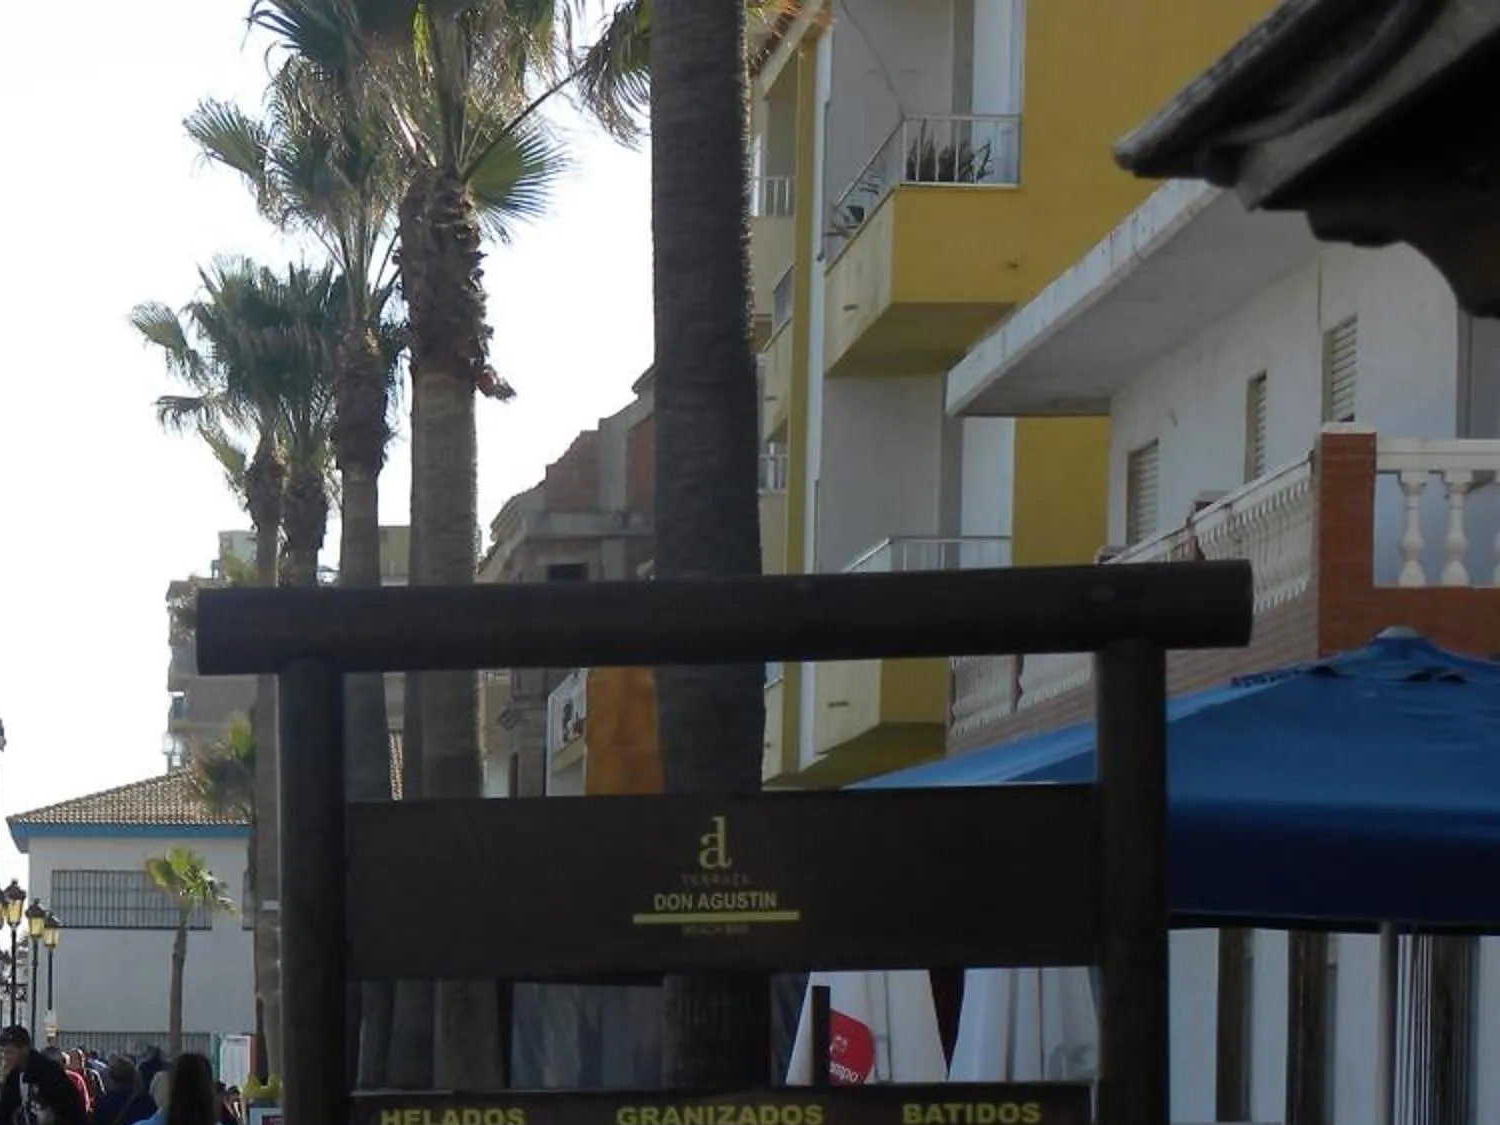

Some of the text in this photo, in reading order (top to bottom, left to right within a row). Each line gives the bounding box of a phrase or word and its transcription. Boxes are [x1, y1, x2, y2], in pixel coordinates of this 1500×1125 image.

[653, 889, 778, 912] DON AGUSTIN
[902, 1102, 1042, 1125] BATIDOS
